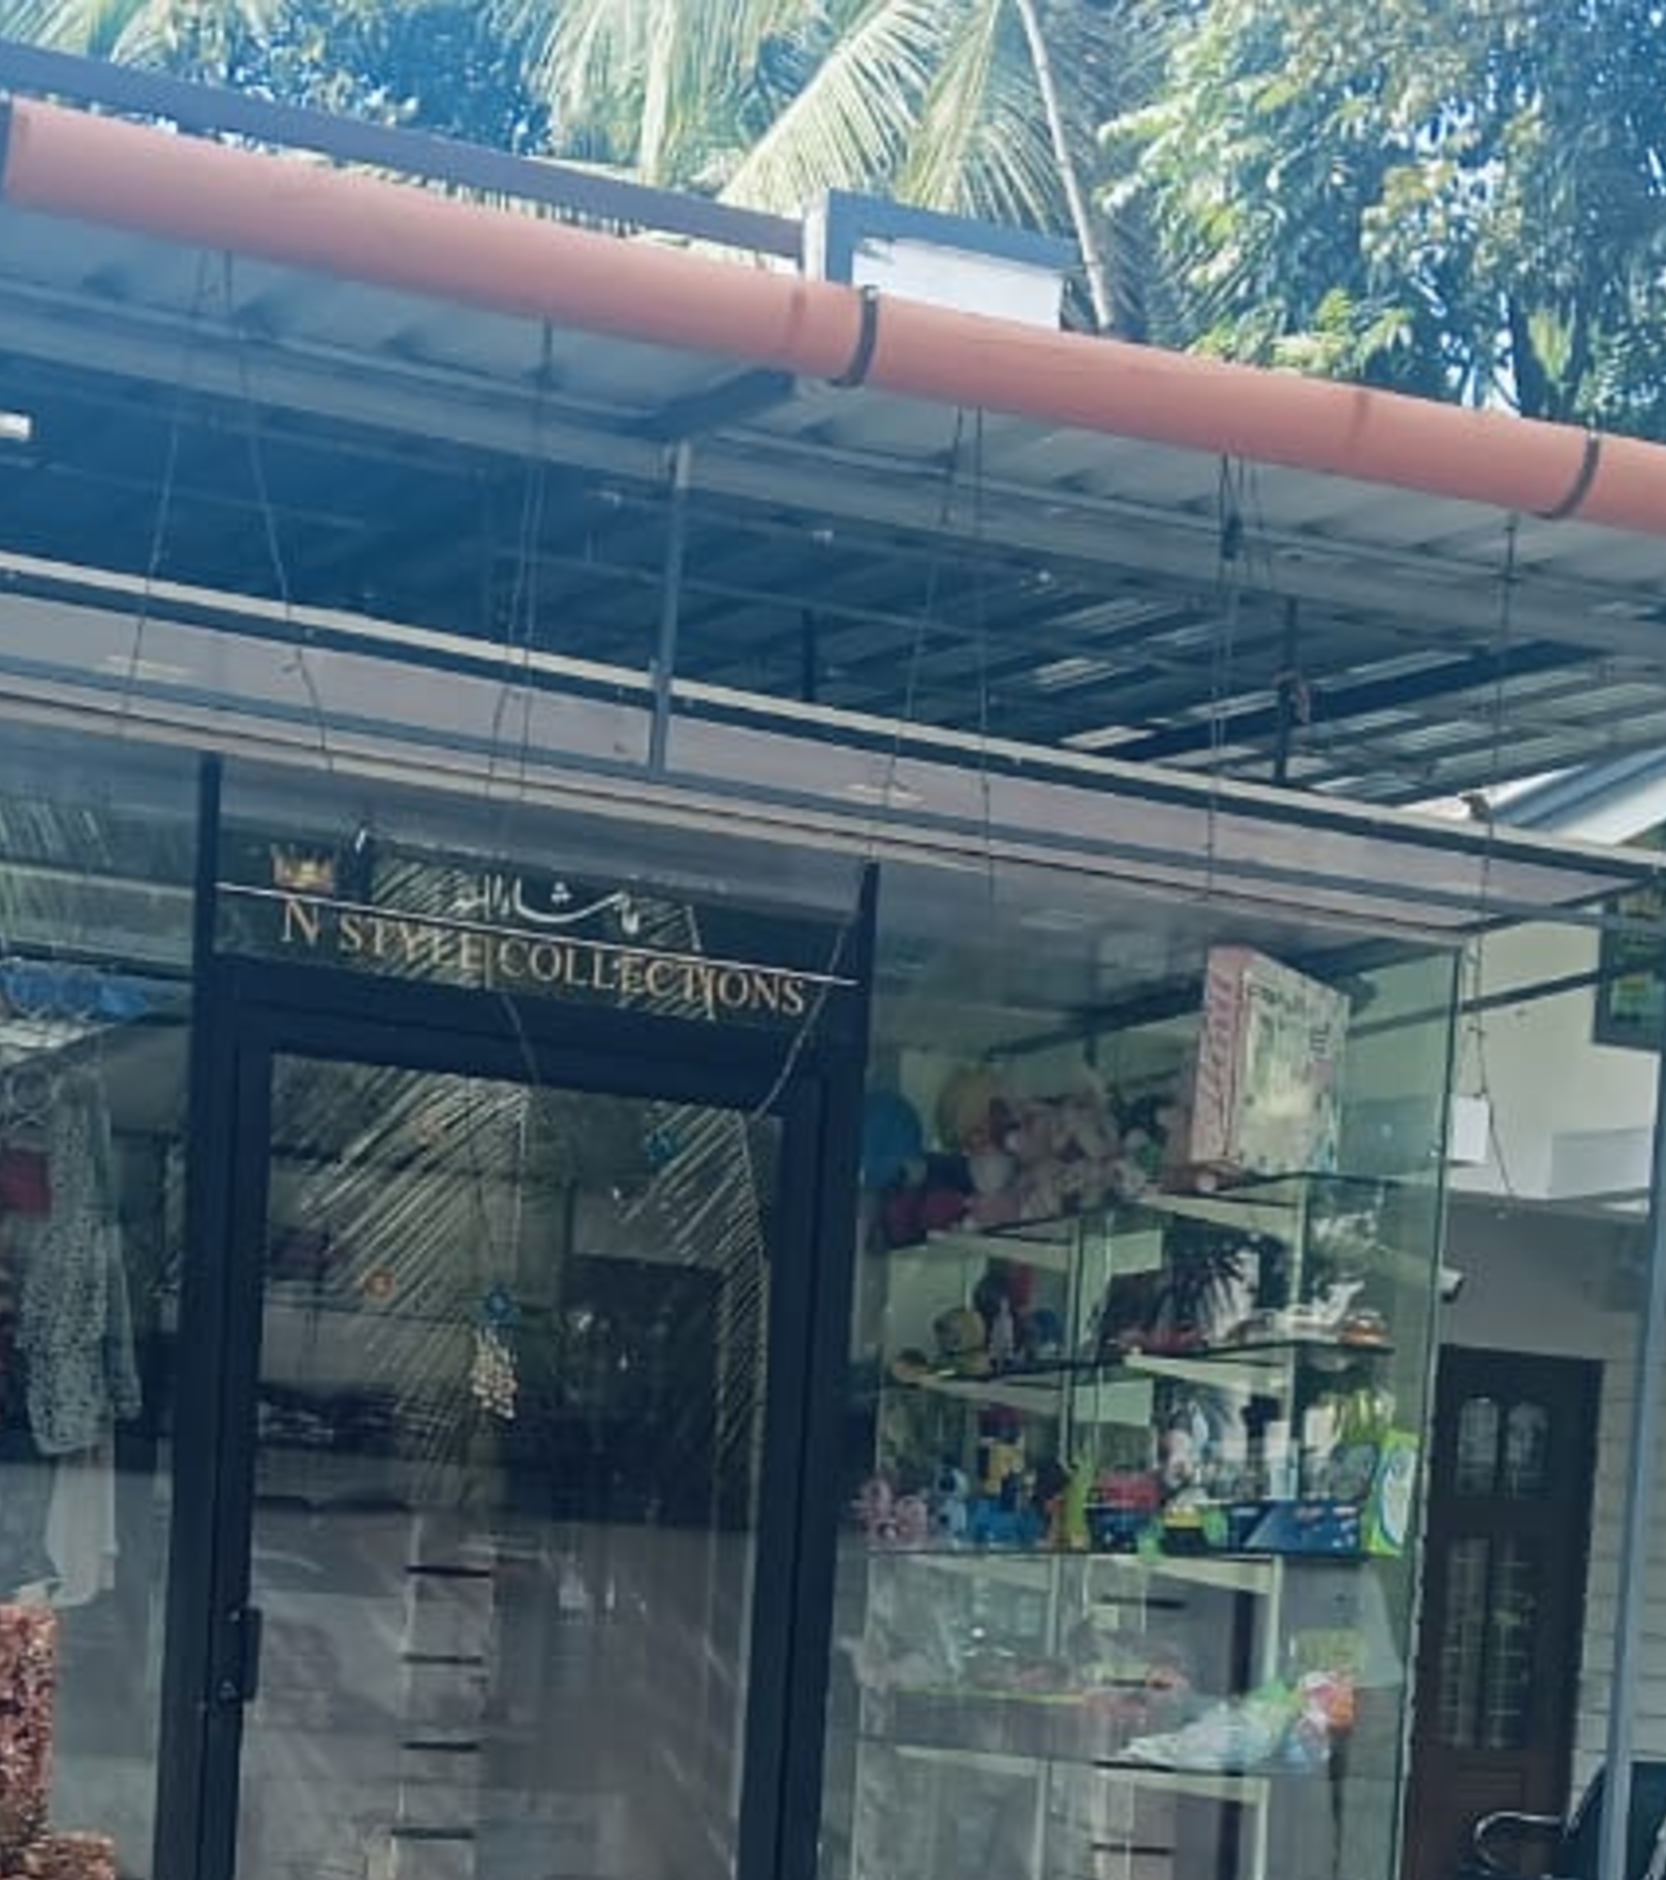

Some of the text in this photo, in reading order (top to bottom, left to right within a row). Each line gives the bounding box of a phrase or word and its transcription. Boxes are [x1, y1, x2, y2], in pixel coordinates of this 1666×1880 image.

[280, 898, 805, 1017] N STYLE COLLECTIONS
